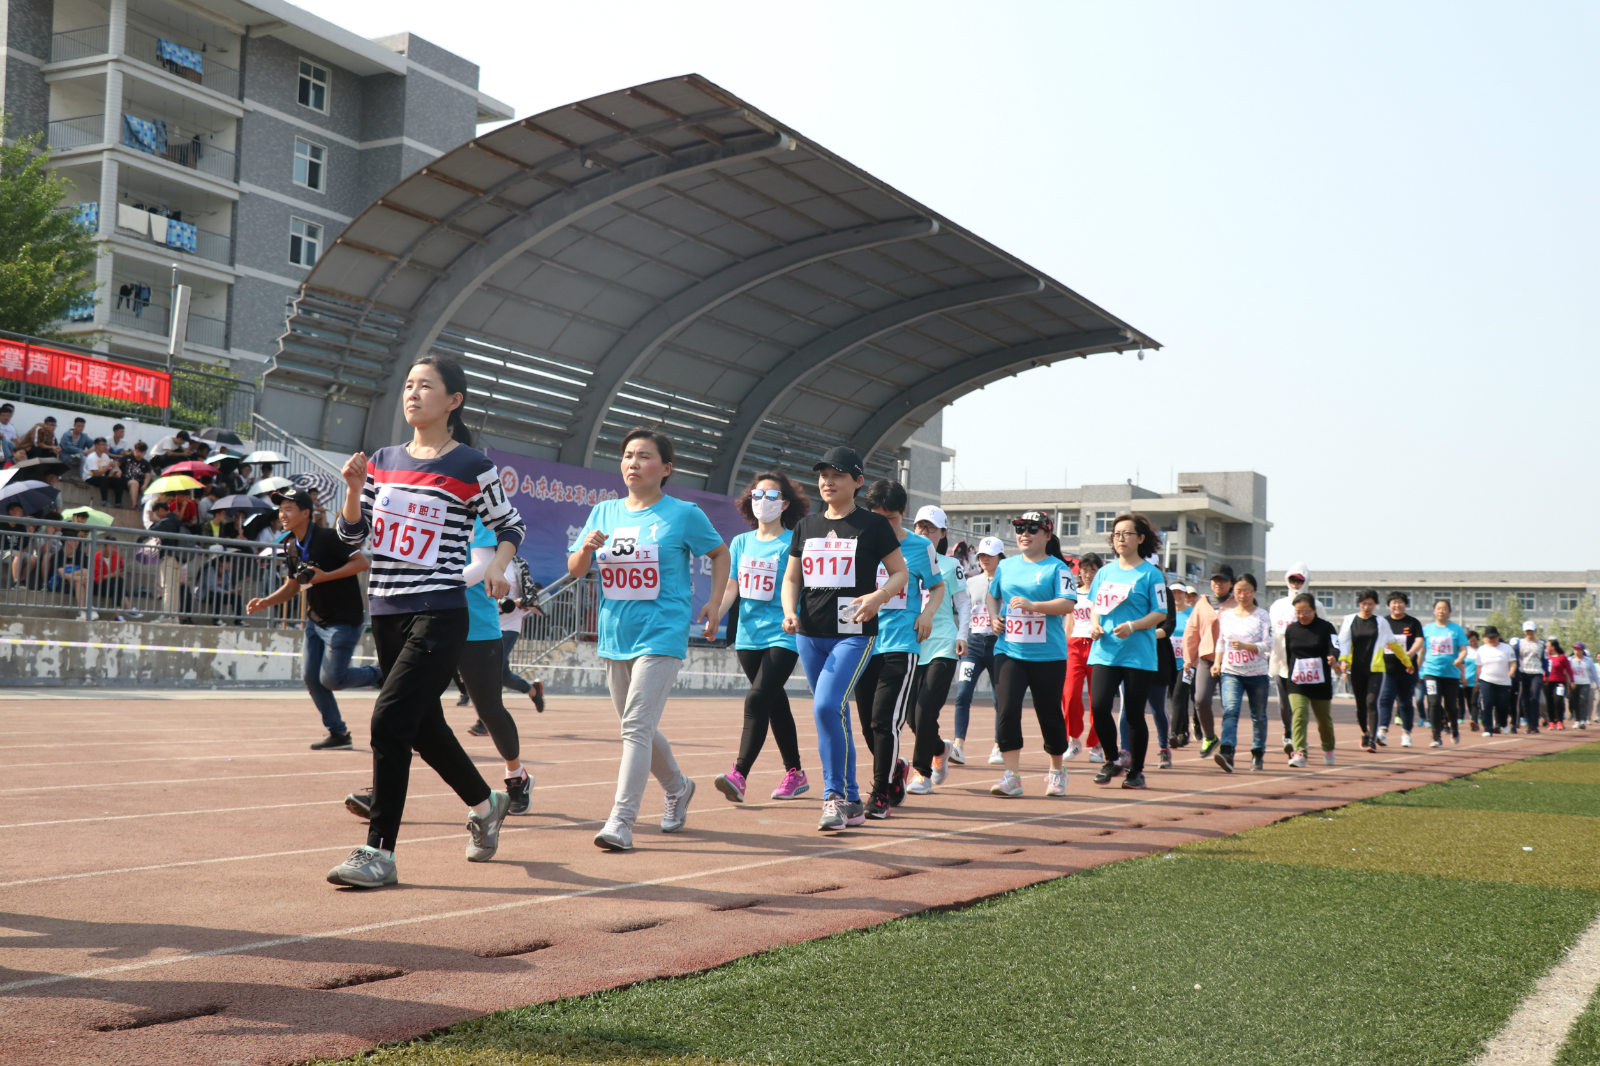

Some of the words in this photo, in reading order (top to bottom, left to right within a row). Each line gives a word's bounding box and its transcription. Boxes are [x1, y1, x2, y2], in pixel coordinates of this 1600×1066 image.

[0, 347, 50, 375] 掌声
[62, 360, 156, 398] 只要尖叫
[482, 479, 505, 507] 17
[408, 502, 441, 519] 教职工
[373, 517, 435, 560] 9157
[611, 537, 636, 556] 53
[802, 556, 853, 576] 9117
[601, 567, 658, 589] 9069
[1006, 620, 1044, 635] 9217
